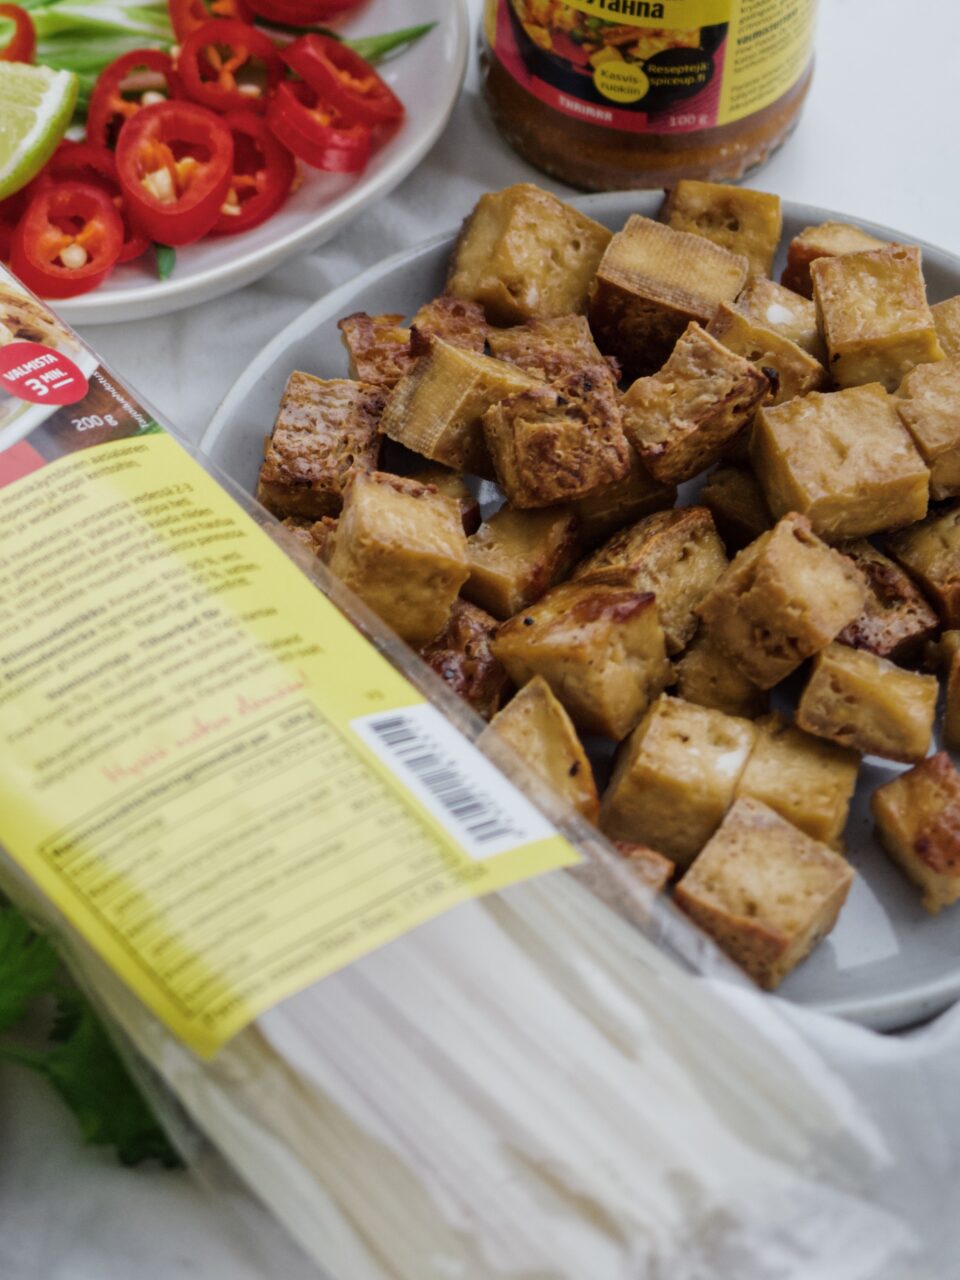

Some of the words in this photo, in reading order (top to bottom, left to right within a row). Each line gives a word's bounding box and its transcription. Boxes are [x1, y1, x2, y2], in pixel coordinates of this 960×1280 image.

[2, 353, 59, 382] VALMISTA
[24, 378, 50, 396] 3
[39, 368, 69, 384] MIN.
[71, 415, 105, 432] 200
[102, 414, 119, 428] g
